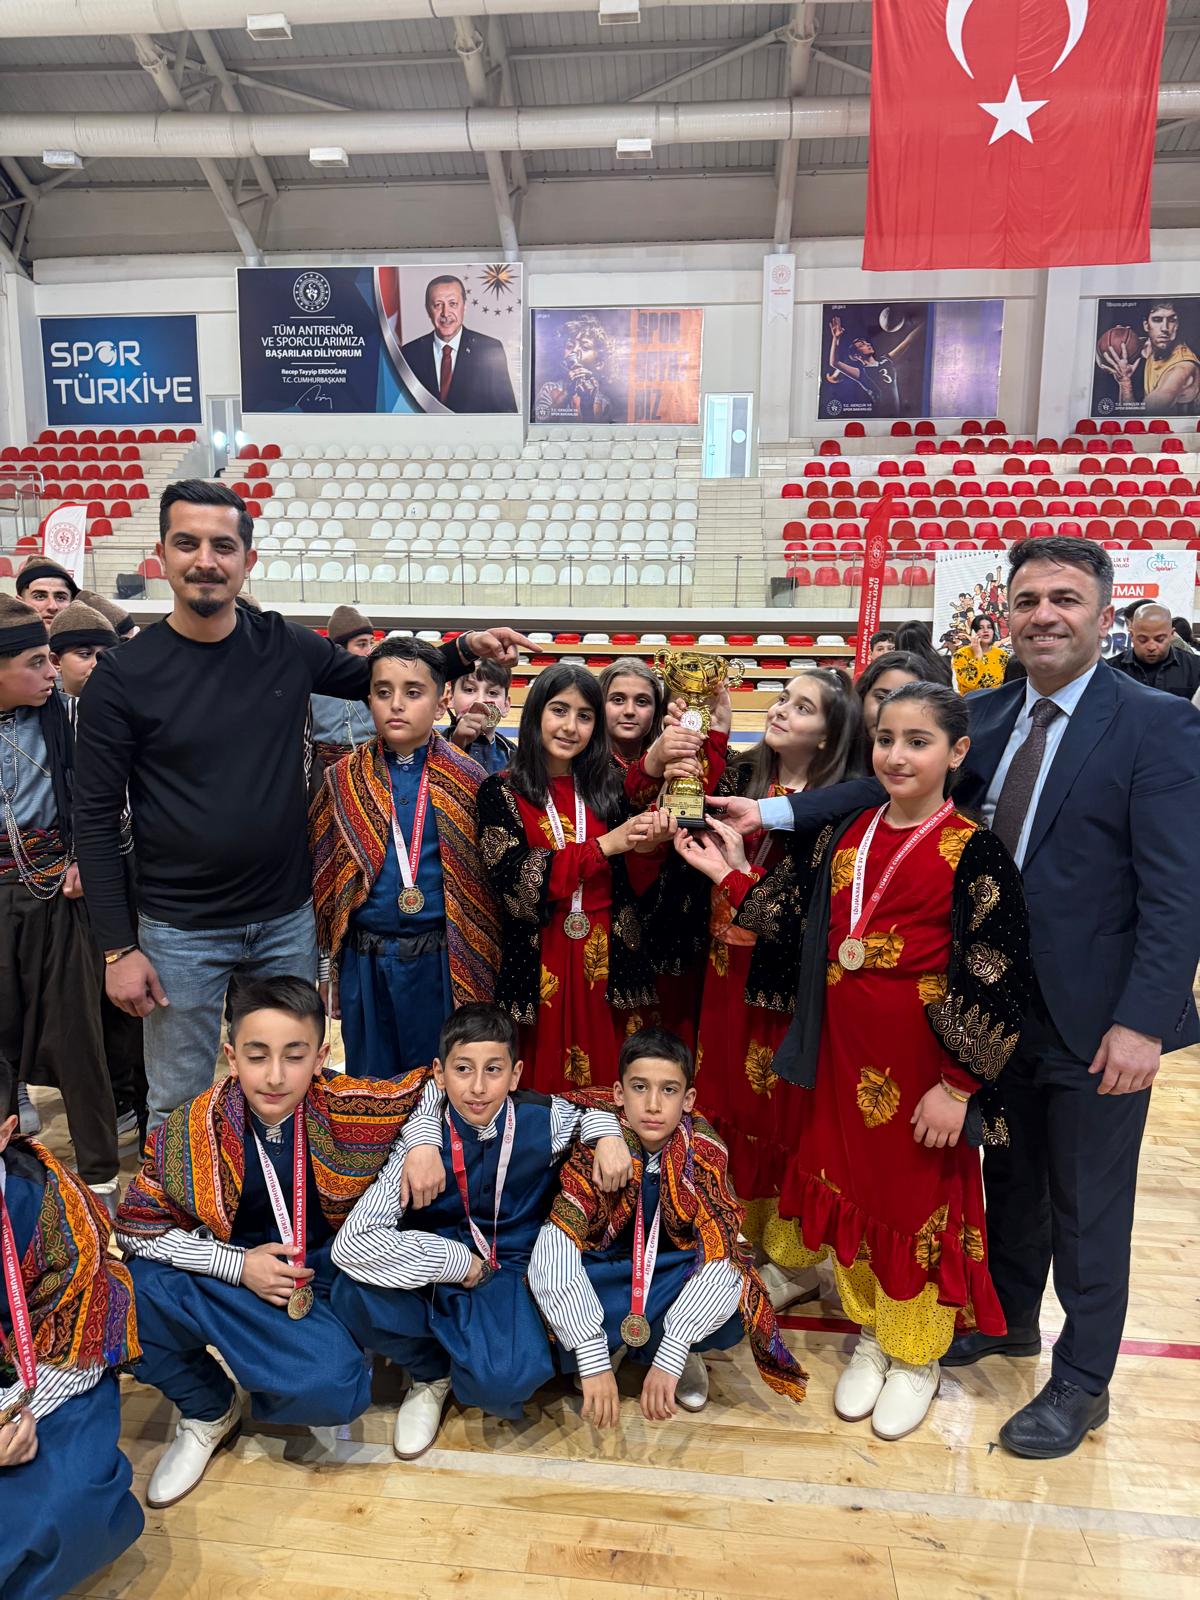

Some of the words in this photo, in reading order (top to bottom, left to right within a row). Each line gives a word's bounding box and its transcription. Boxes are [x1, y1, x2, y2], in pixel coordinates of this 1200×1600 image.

[272, 324, 296, 336] TÜM
[298, 323, 354, 336] ANTRENÖR
[261, 337, 275, 347] VE
[276, 336, 366, 347] SPORCULARIMIZA
[50, 340, 142, 368] SPOR
[265, 349, 313, 359] BAŞARILAR
[314, 347, 362, 358] DİLİYORUM
[281, 368, 298, 376] Recep
[299, 368, 317, 376] Tayyip
[317, 367, 347, 375] ERDOĞAN
[282, 376, 293, 384] T.C.
[293, 376, 347, 385] CUMHURBAŞKANI
[53, 371, 193, 405] TÜRKİYE
[1112, 585, 1145, 596] TMAN
[861, 628, 869, 665] BATMAN
[869, 576, 875, 588] VE
[879, 866, 894, 889] TÜRKİYE
[893, 832, 920, 866] CUMHURİYETİ
[296, 1187, 303, 1197] VE
[6, 1256, 23, 1309] CUMHURİYETİ
[15, 1309, 28, 1344] GENÇLİK
[21, 1343, 30, 1354] VE
[24, 1354, 33, 1382] SPOR
